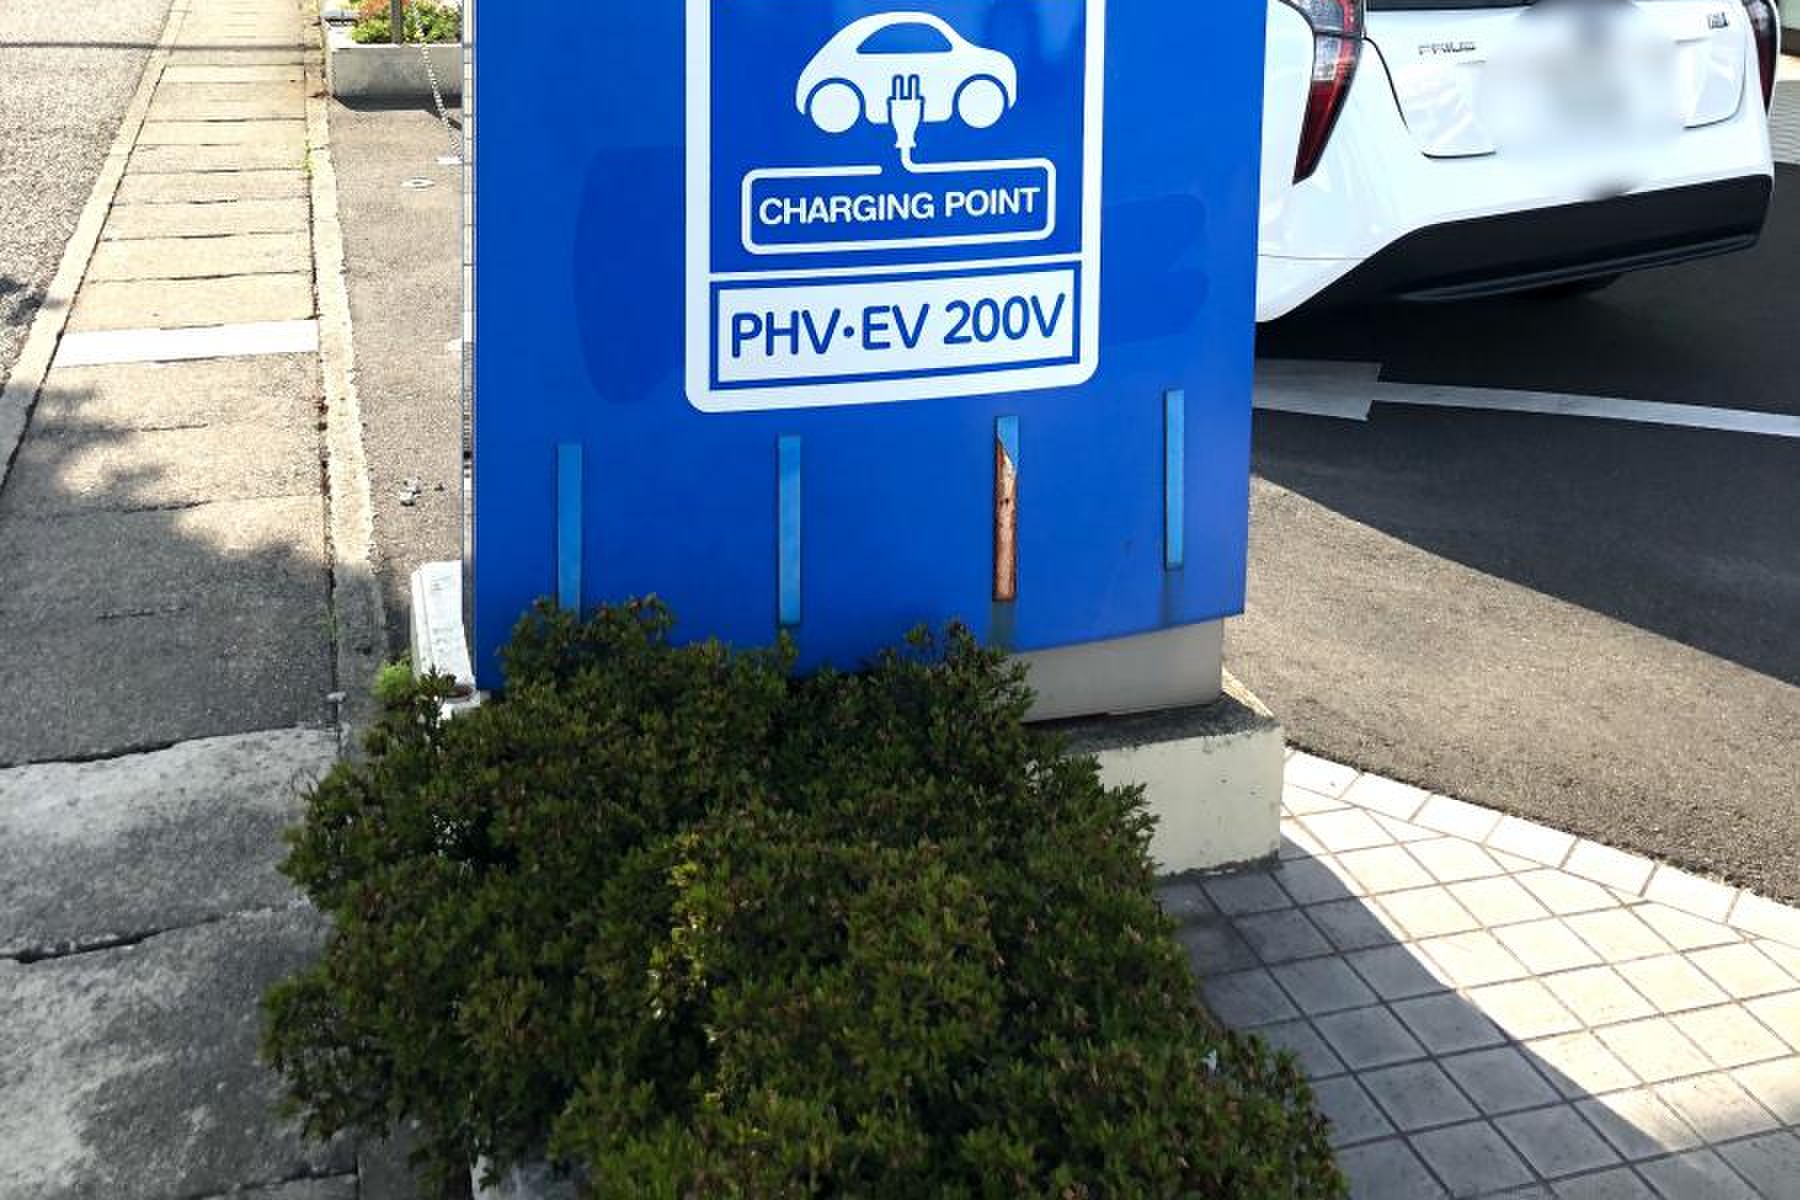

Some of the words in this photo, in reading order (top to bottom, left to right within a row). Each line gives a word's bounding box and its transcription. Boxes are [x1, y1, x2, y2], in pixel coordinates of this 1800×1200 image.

[759, 192, 935, 225] CHARGING
[945, 187, 1041, 217] POINT
[943, 292, 1066, 345] 200V
